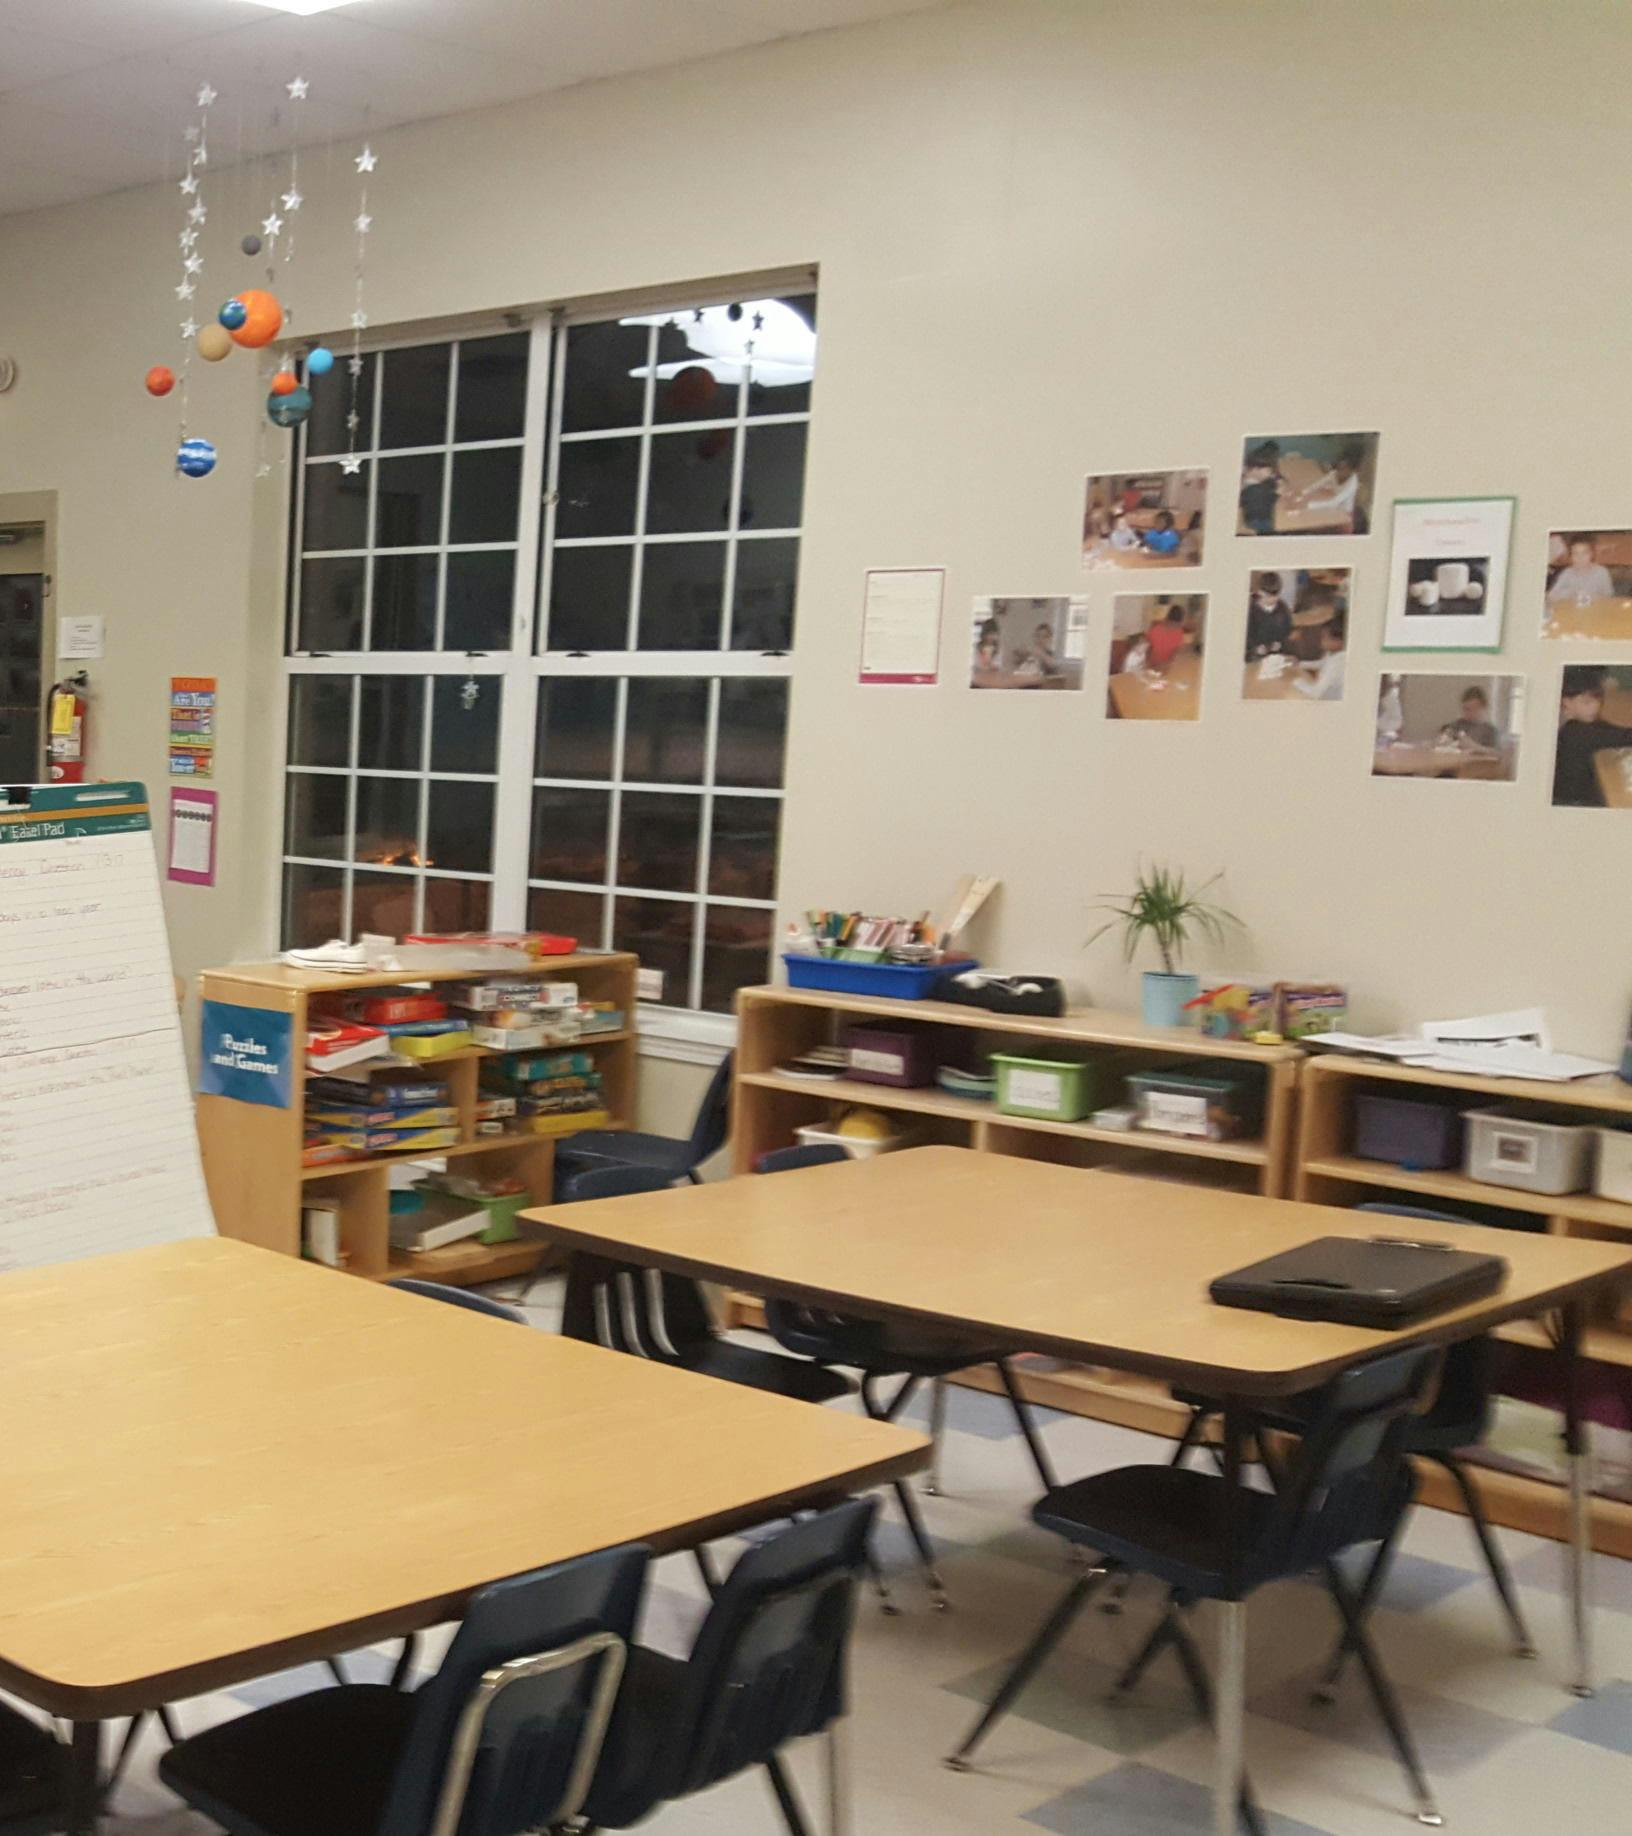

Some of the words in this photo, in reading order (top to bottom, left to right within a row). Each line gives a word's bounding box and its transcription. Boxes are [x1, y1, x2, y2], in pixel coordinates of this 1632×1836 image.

[43, 822, 65, 836] Pad
[222, 1032, 268, 1056] Puzzles
[211, 1051, 237, 1067] and
[236, 1053, 279, 1075] Games
